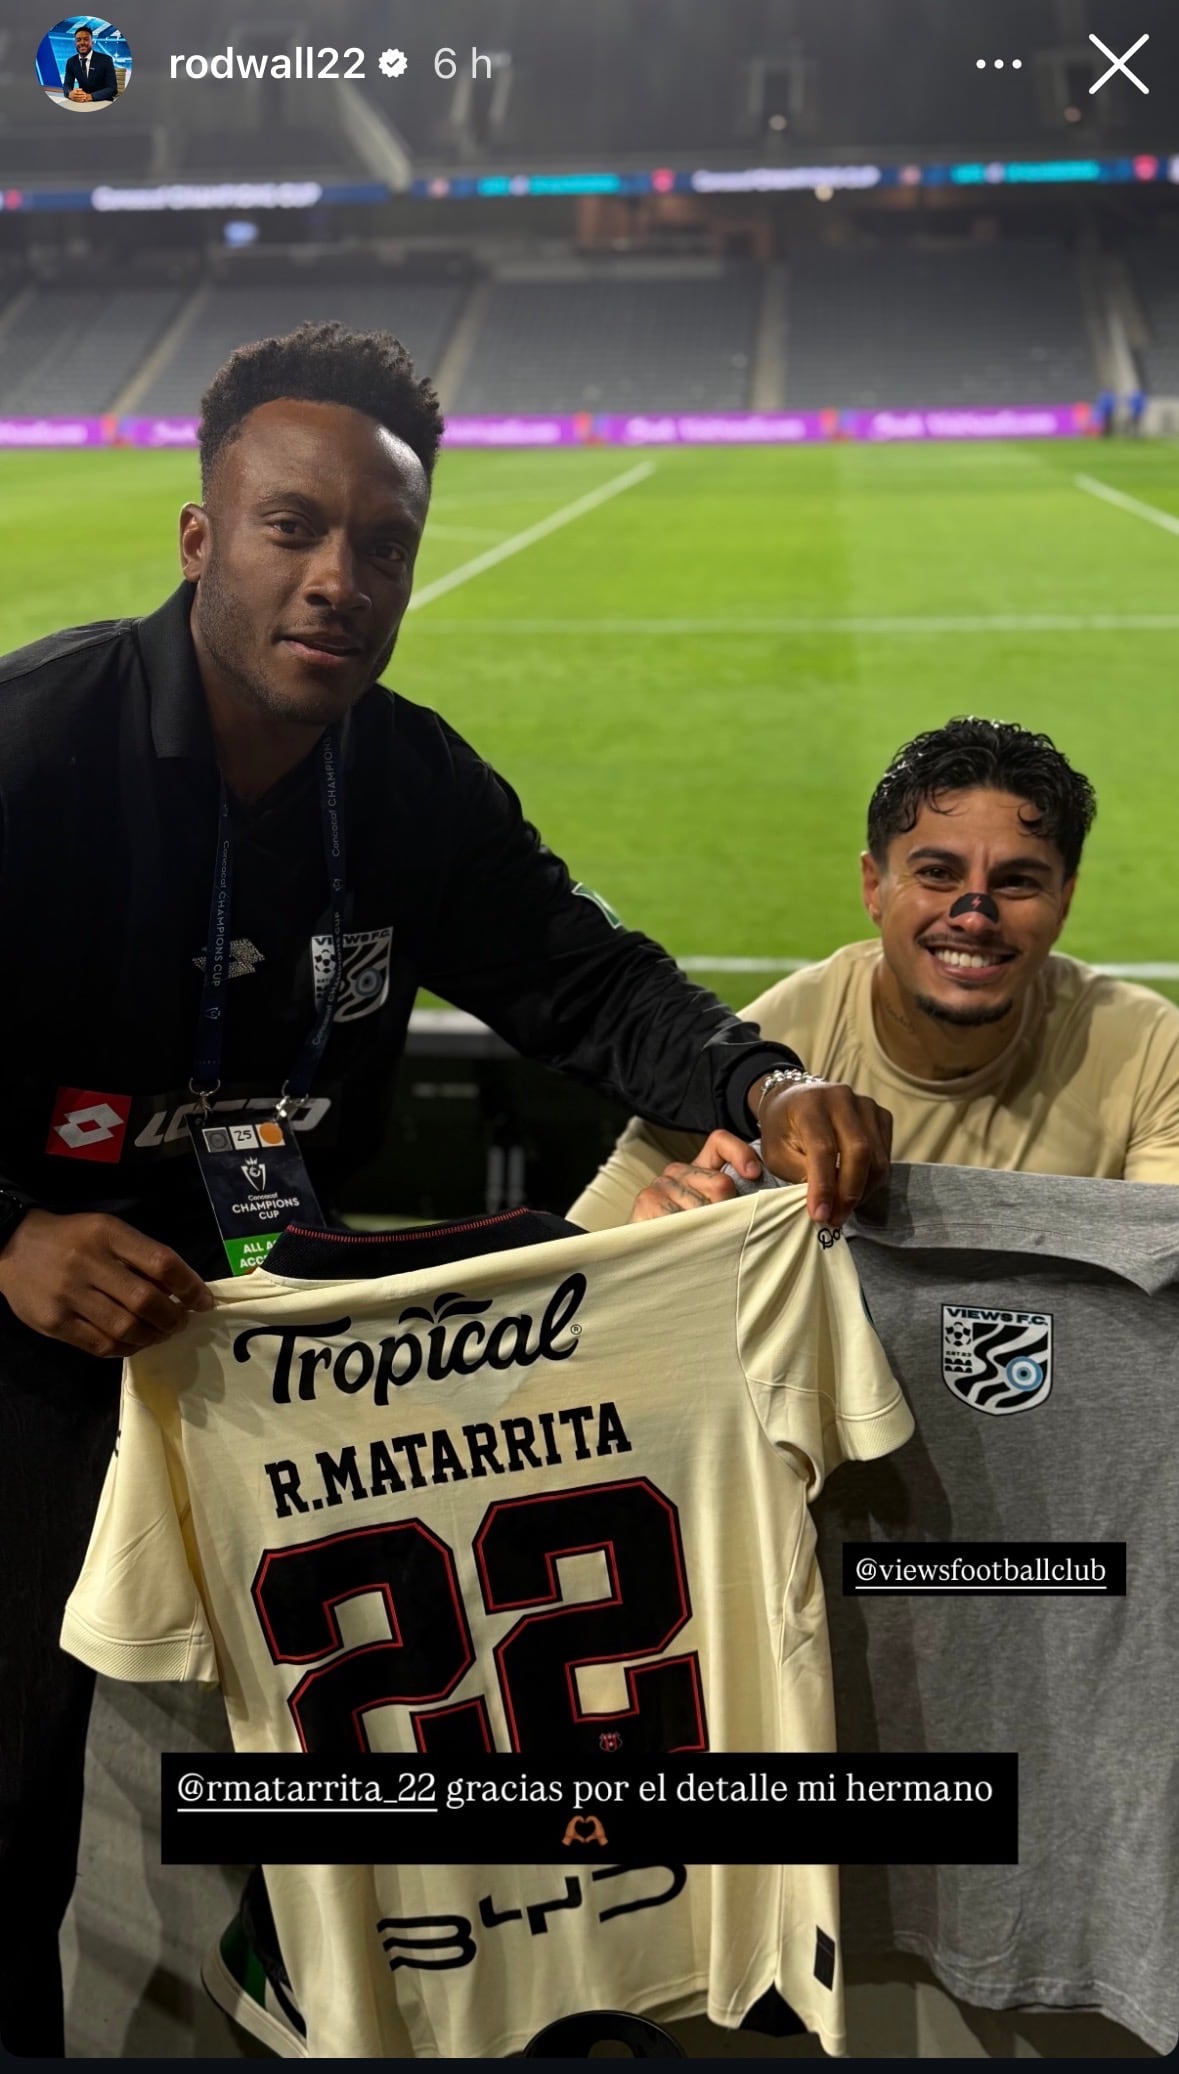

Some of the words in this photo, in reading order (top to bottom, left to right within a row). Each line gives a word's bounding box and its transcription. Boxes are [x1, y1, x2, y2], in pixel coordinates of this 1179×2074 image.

[213, 890, 227, 962] CHAMPIONS
[211, 963, 222, 987] CUP
[233, 1129, 252, 1142] 25
[232, 1197, 300, 1214] CHAMPIONS
[258, 1210, 280, 1220] CUP
[243, 1242, 264, 1254] ALL
[946, 1307, 1013, 1323] VIEWS
[1016, 1314, 1048, 1327] F.C.
[264, 1402, 633, 1519] R.MATARRITA
[250, 1476, 710, 1753] 22
[376, 1863, 687, 1972] BYD
